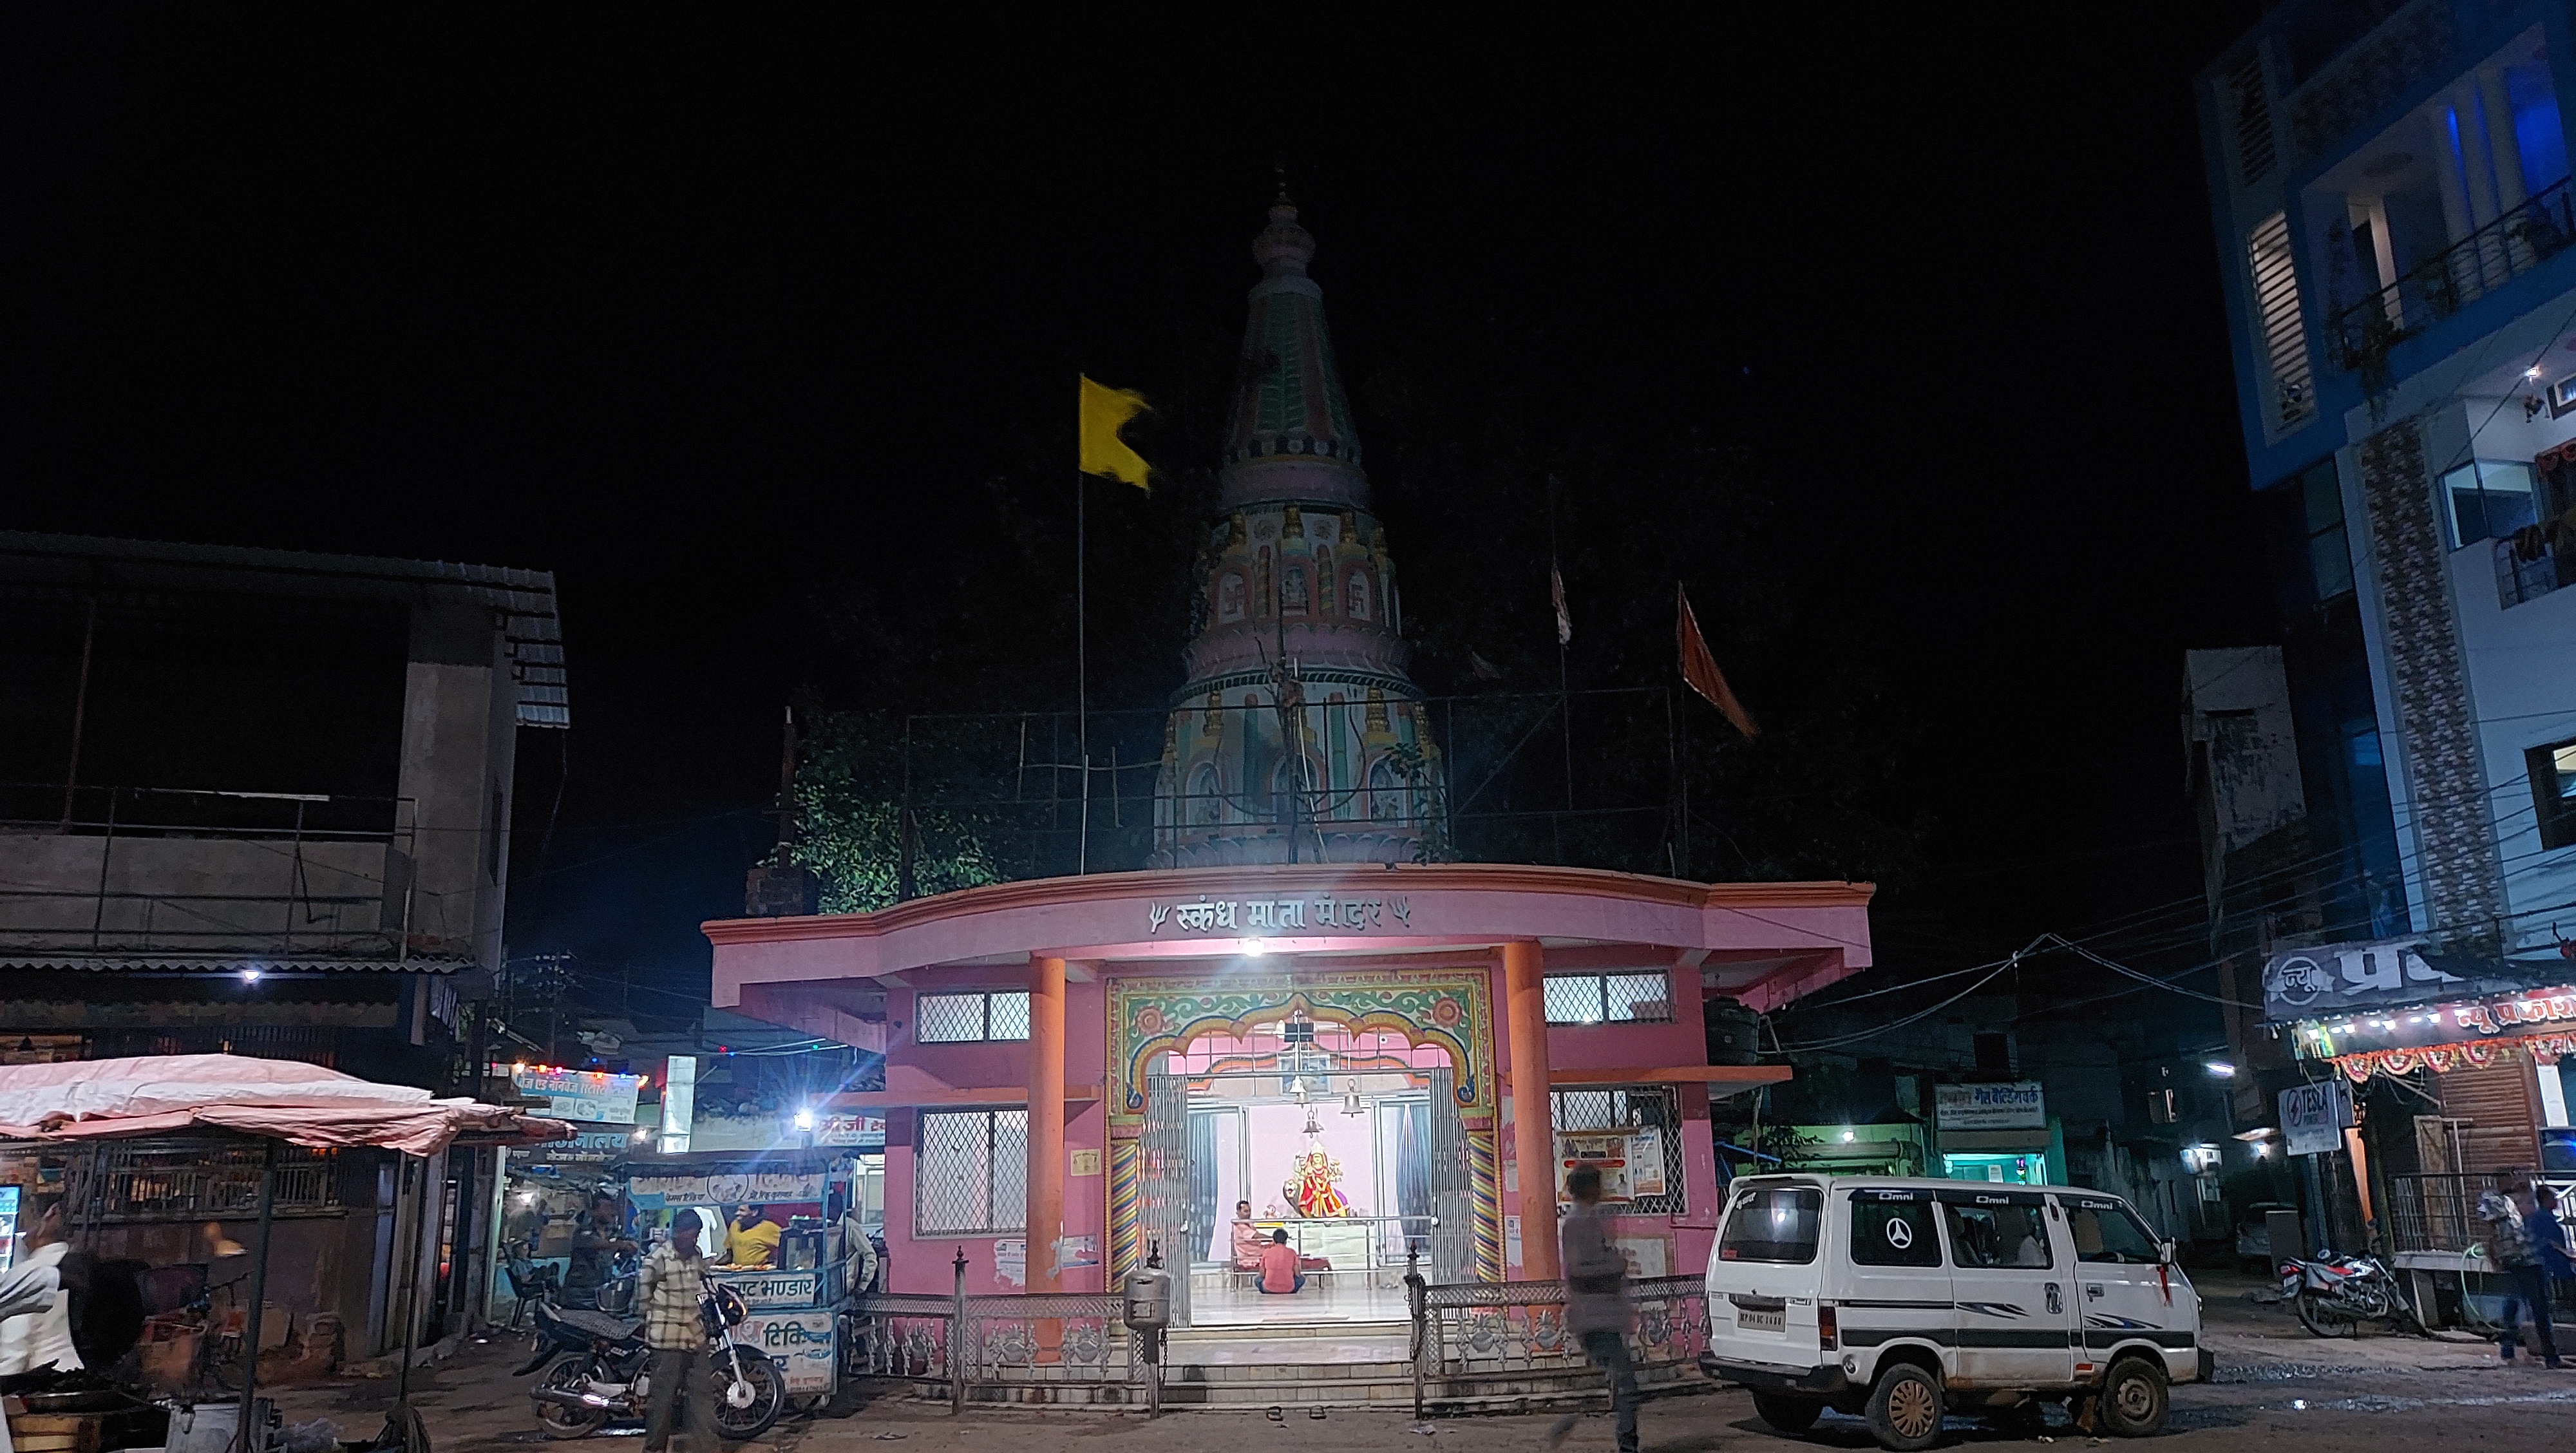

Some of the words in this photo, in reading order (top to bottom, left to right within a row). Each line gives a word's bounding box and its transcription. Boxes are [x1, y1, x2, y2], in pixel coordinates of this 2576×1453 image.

[1176, 895, 1238, 931] स्कंध
[1246, 900, 1306, 929] माता
[2282, 966, 2316, 992] न्यू
[2454, 1006, 2500, 1034] न्यू
[2302, 1086, 2329, 1114] TESLA
[842, 1116, 866, 1131] जी
[1879, 1192, 1913, 1201] Omni
[1976, 1195, 2009, 1204] Omni
[2081, 1200, 2113, 1210] Omni
[761, 1279, 813, 1296] भण्डार
